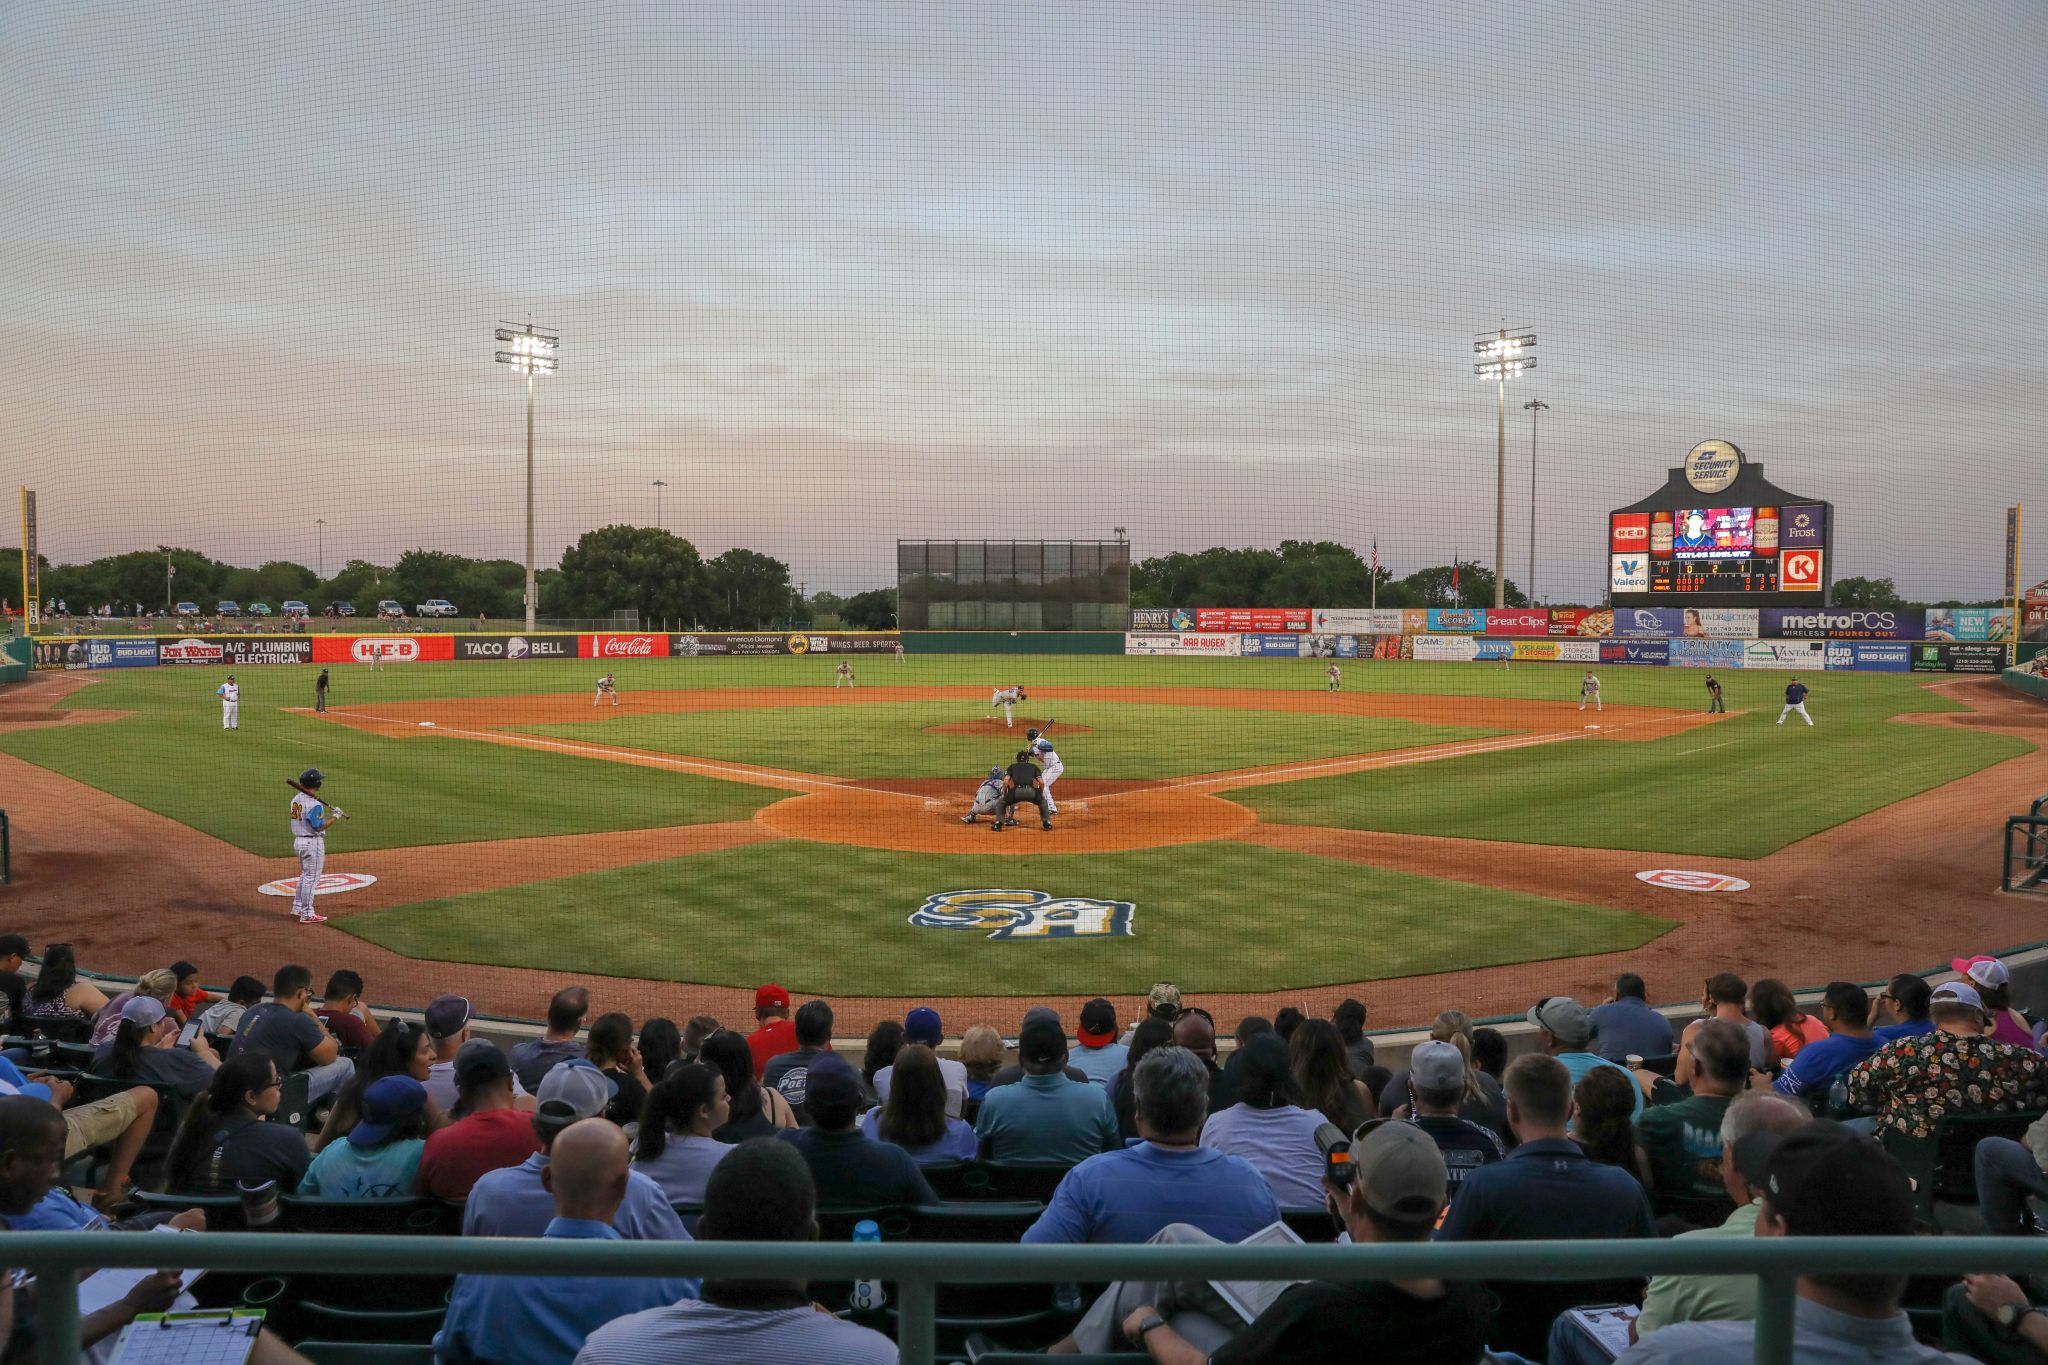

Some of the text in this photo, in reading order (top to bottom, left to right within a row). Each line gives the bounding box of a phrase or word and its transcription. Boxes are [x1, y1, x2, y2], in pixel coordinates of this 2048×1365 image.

[1693, 460, 1735, 470] SECURITY
[1693, 470, 1728, 480] SERVICE
[1788, 528, 1816, 538] Frost
[1686, 565, 1693, 573] 0
[1712, 564, 1718, 573] 2
[1614, 578, 1646, 586] Valero
[30, 602, 38, 624] 310
[1134, 612, 1168, 624] HENRY'S
[1486, 616, 1545, 628] Great Clips
[1960, 616, 1984, 626] NEW
[225, 642, 310, 653] A/C PLUMBING
[605, 638, 653, 655] Coca-Cola
[1184, 638, 1226, 648] AAA AUGER
[1682, 640, 1730, 650] TRINITY
[90, 644, 111, 654] BUD
[162, 646, 222, 658] JON WAYNE
[464, 642, 564, 655] TACO BELL
[1769, 645, 1818, 661] VANTAGE
[1828, 648, 1850, 656] BUD
[88, 654, 112, 664] LIGHT
[235, 653, 302, 664] ELECTRICAL
[1825, 656, 1854, 666] LIGHT
[1878, 653, 1904, 661] LIGHT
[1914, 661, 1936, 669] Holiday
[908, 889, 1136, 939] SA
